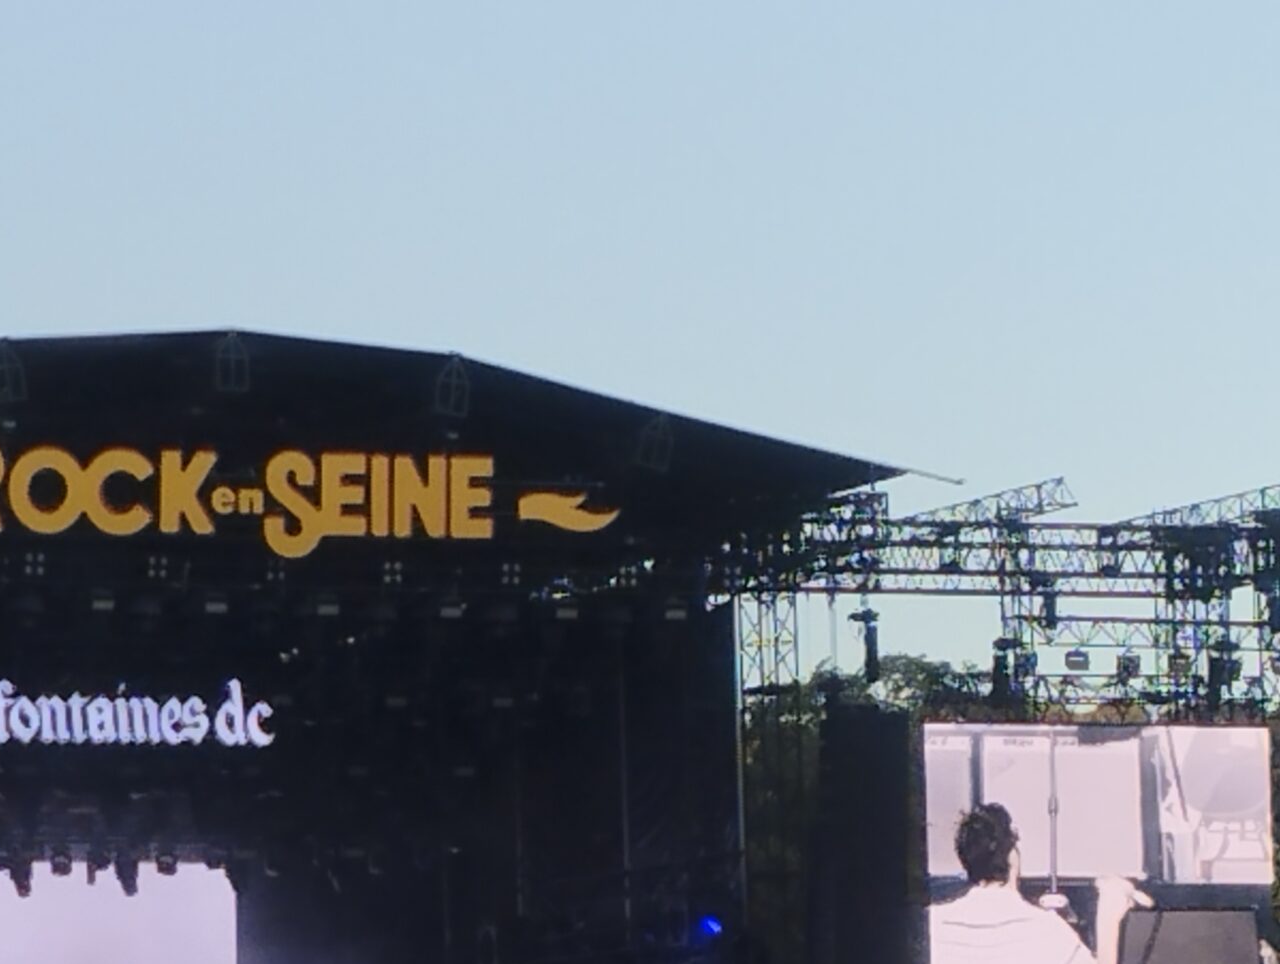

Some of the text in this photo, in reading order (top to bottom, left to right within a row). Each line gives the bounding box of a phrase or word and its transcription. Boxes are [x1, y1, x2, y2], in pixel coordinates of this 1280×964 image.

[211, 485, 264, 514] en
[262, 449, 494, 558] SEINE
[214, 677, 276, 748] dc
